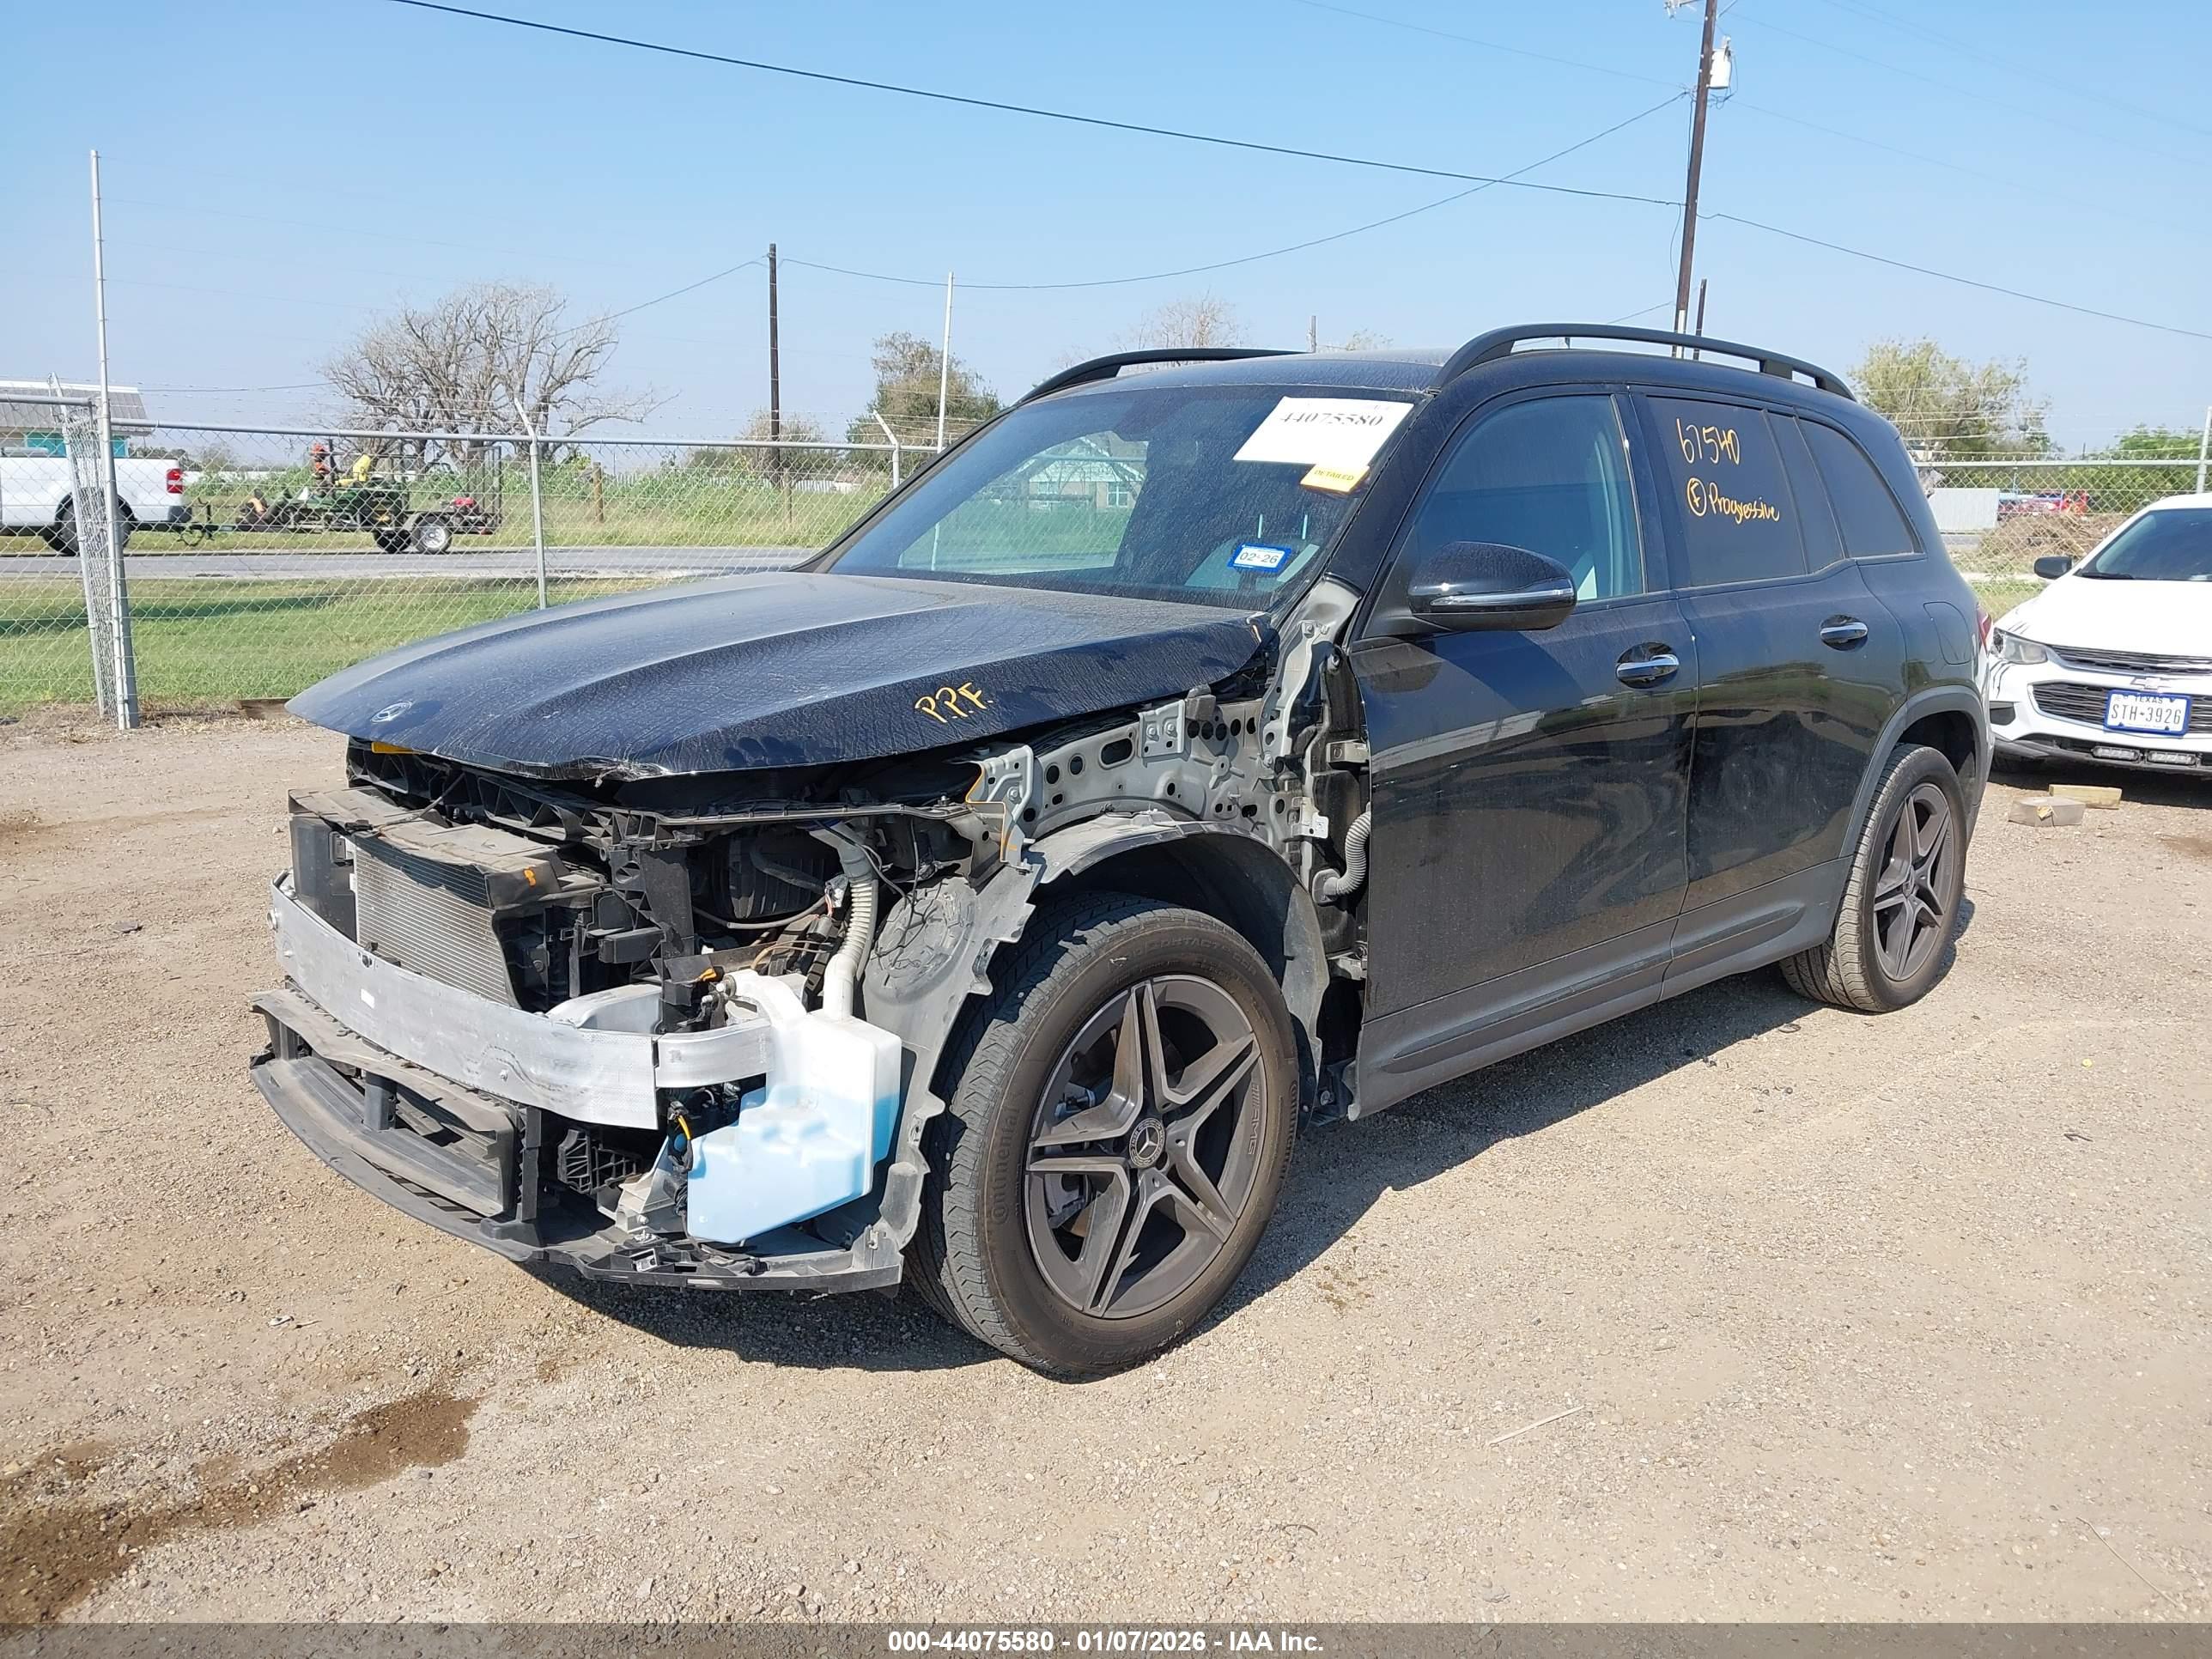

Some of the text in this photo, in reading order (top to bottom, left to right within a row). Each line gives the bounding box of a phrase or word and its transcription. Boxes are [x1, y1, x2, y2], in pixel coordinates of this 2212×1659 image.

[1279, 412, 1384, 427] 44075580
[1314, 469, 1355, 481] DETAILED
[2134, 695, 2163, 704] TEXAS
[2111, 703, 2182, 725] STH-3926
